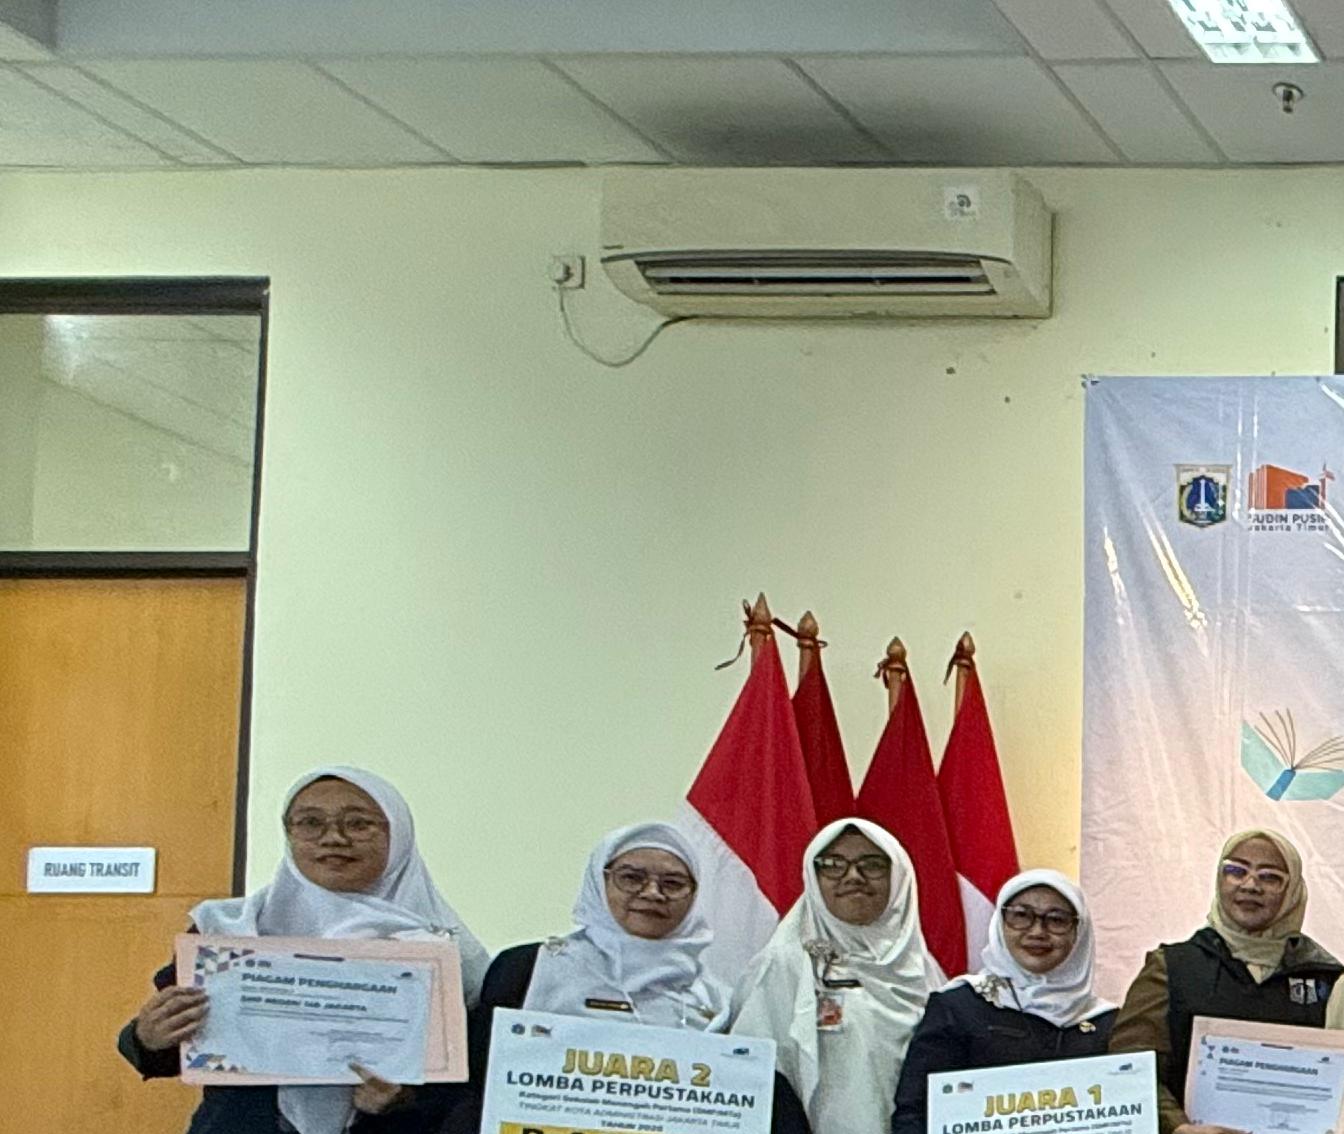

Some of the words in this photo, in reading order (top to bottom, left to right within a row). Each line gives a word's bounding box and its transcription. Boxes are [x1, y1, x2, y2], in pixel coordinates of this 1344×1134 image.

[44, 862, 86, 877] RUANG
[89, 862, 140, 877] TRANSIT
[562, 1048, 680, 1084] JUARA
[690, 1063, 712, 1087] 2
[506, 1071, 585, 1092] LOMBA
[591, 1081, 755, 1108] PERPUSTAKAAN
[984, 1087, 1079, 1117] JUARA
[1087, 1084, 1103, 1105] 1
[1009, 1103, 1142, 1129] PERPUSTAKAAN
